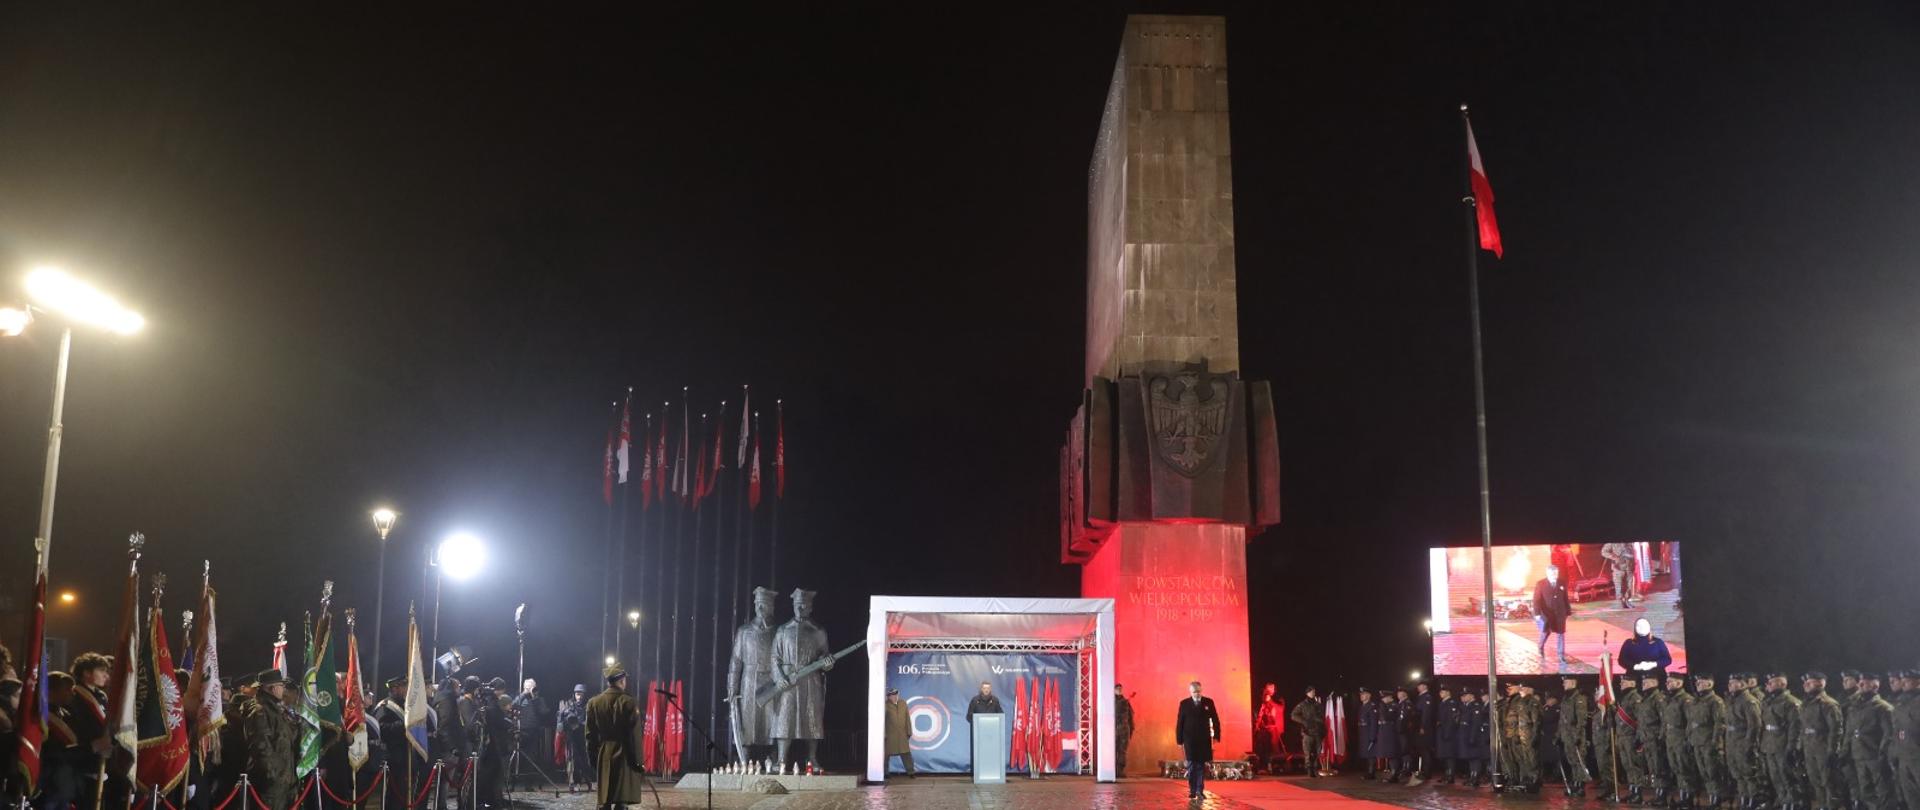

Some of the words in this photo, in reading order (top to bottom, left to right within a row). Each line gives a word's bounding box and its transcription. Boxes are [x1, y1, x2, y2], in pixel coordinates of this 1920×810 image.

[1129, 592, 1240, 607] WIELKOPOLSKIM
[1157, 609, 1178, 622] 1918
[1190, 608, 1213, 622] 1919
[898, 664, 921, 675] 106.
